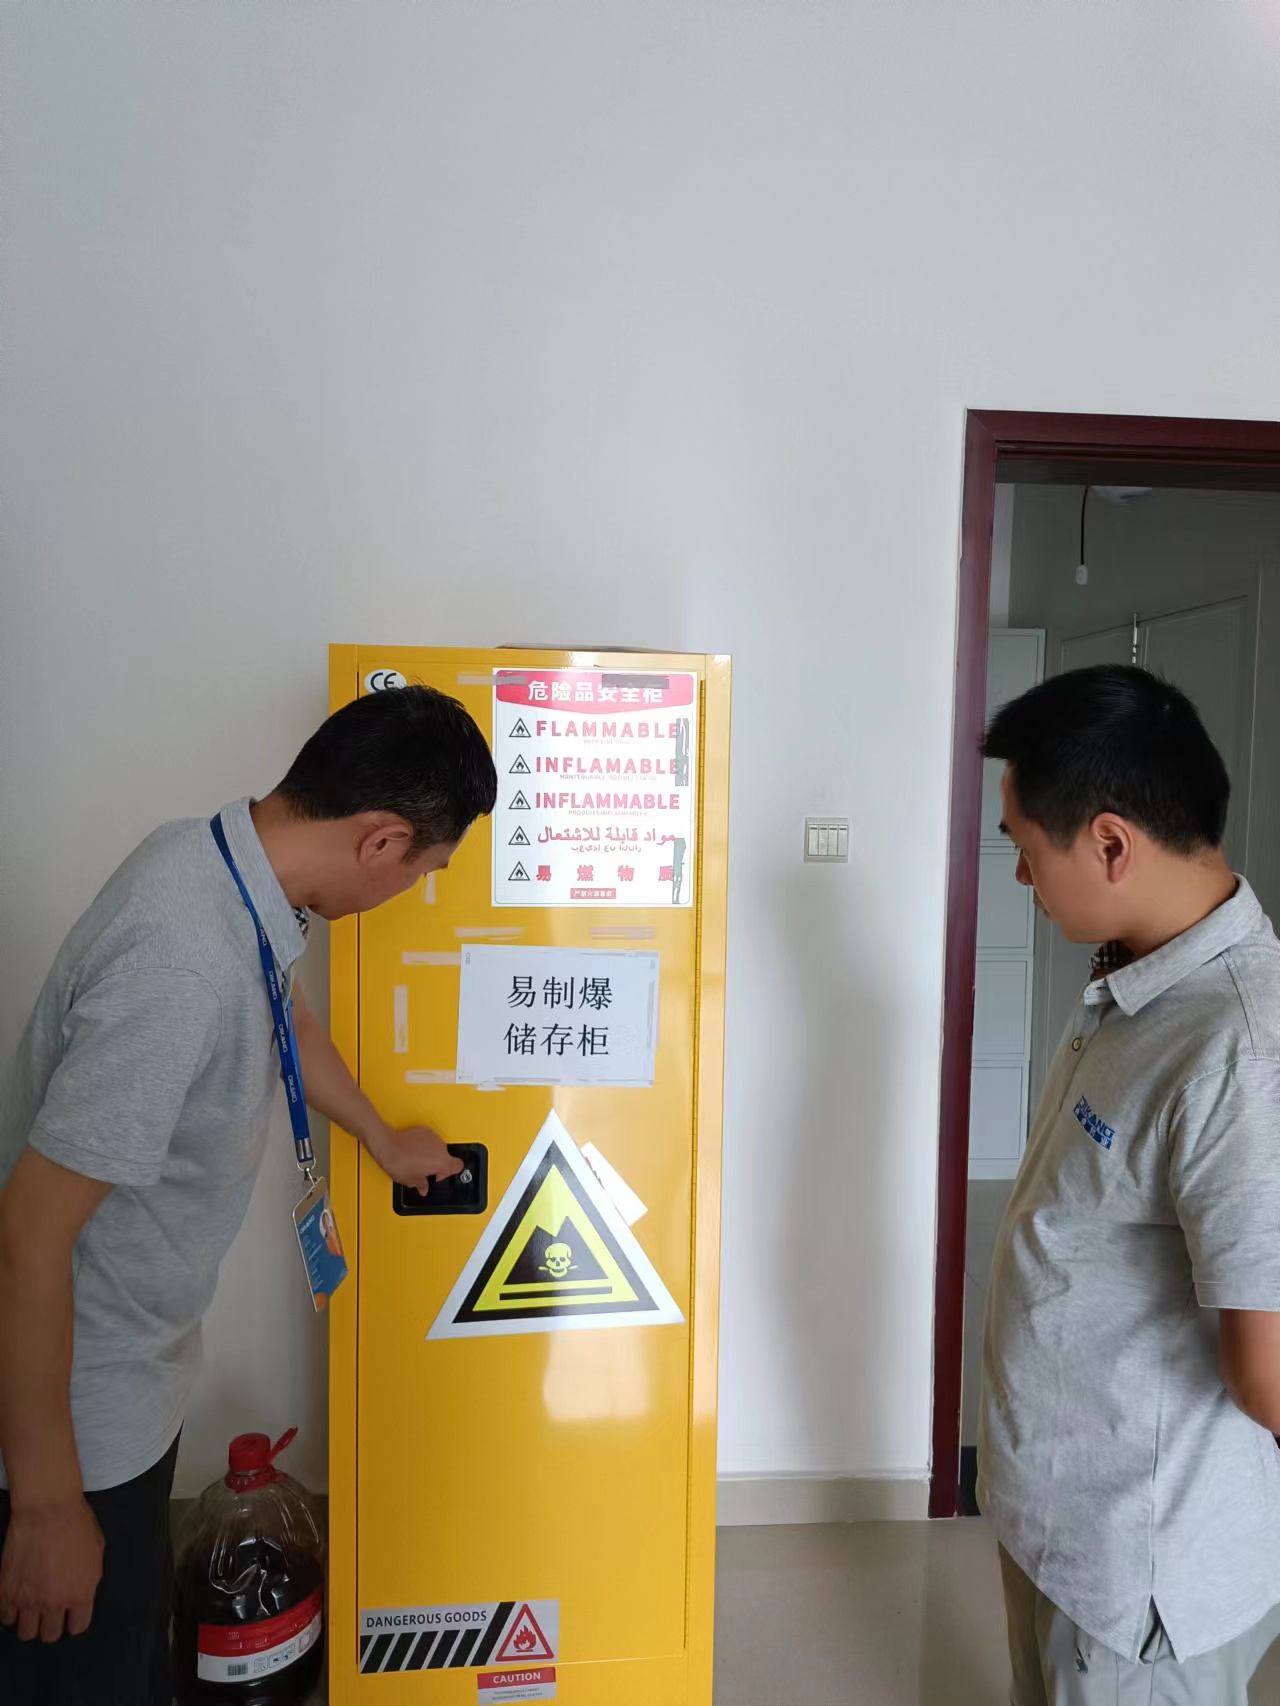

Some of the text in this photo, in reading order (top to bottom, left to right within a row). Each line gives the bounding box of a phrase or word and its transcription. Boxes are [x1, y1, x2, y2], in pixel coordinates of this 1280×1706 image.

[370, 672, 396, 690] CE
[536, 720, 679, 739] FLAMMABLE
[536, 756, 679, 775] INFLAMABLE
[535, 792, 681, 810] INFLAMMABLE
[507, 975, 613, 1011] 易制爆
[503, 1022, 610, 1057] 储存柜
[366, 1610, 487, 1628] DANGEROUS GOODS
[492, 1671, 541, 1684] CAUTION
